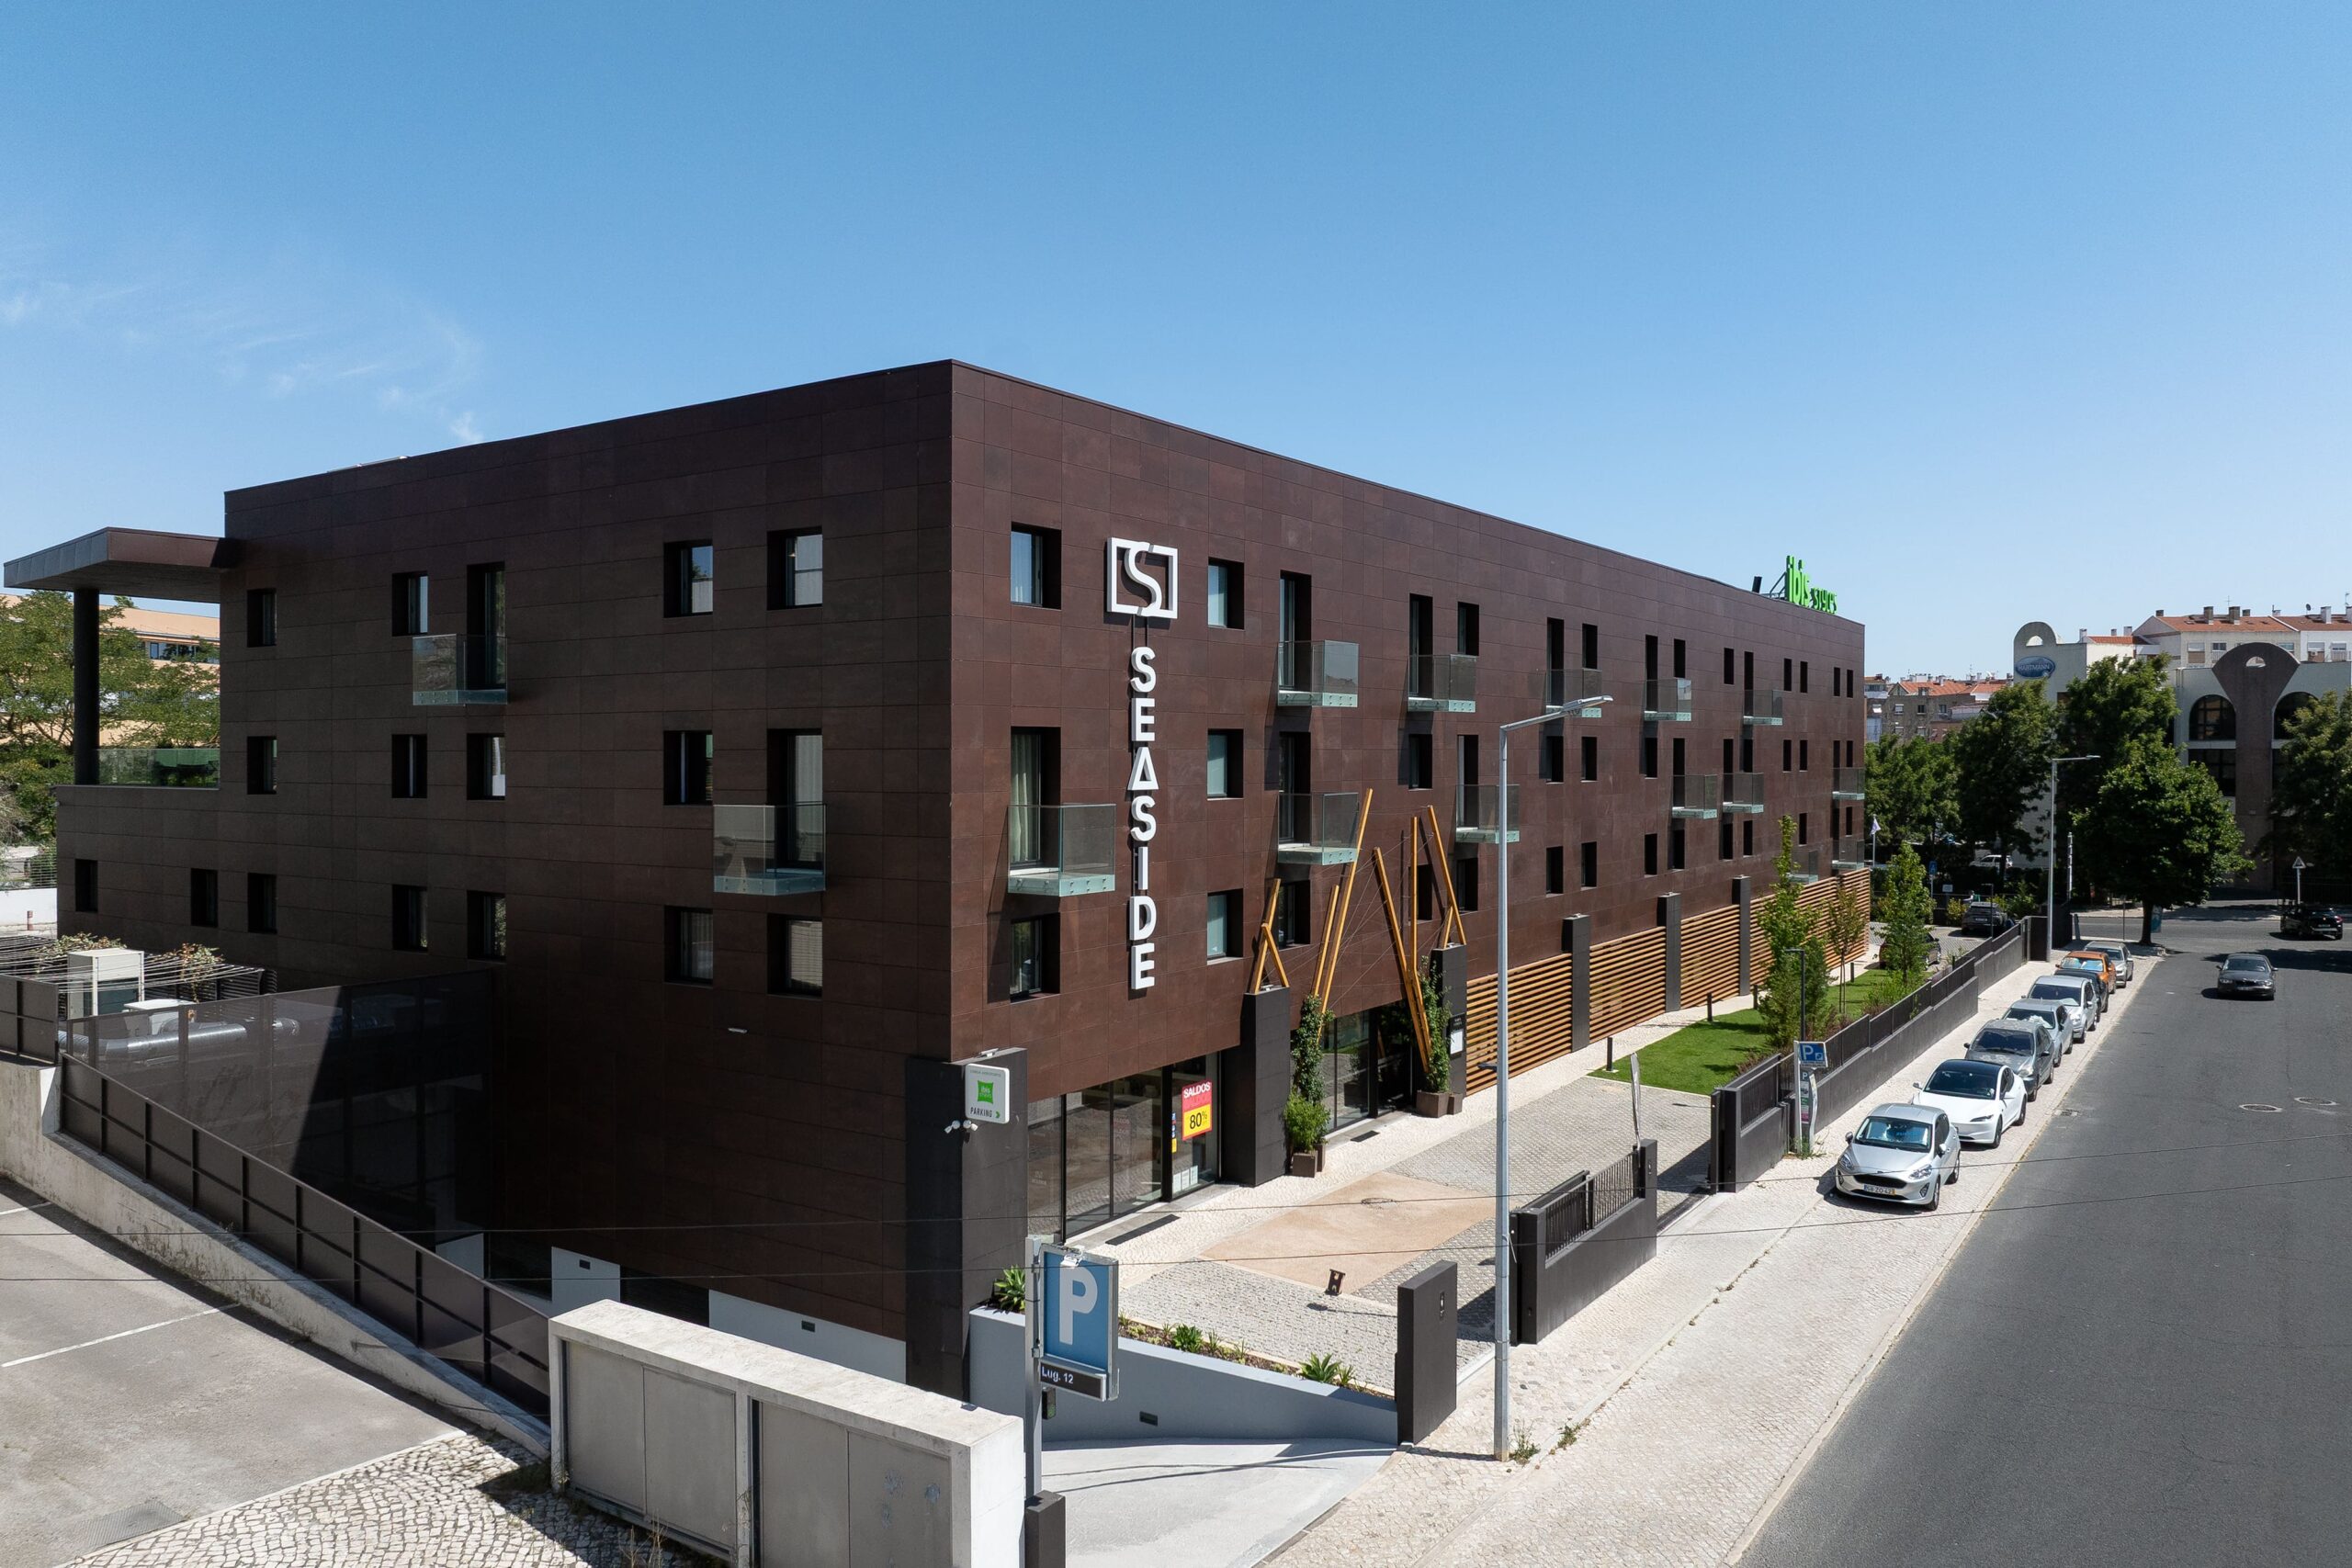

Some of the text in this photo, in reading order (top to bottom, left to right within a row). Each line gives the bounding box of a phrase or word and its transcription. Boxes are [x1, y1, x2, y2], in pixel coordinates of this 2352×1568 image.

[1786, 555, 1809, 607] ibis
[1127, 646, 1159, 990] SEASIDE
[1802, 1044, 1814, 1060] P
[1183, 1081, 1211, 1099] SALDOS
[970, 1106, 993, 1118] PARKING
[1059, 1263, 1098, 1346] P
[1042, 1365, 1074, 1384] Lug. 12
